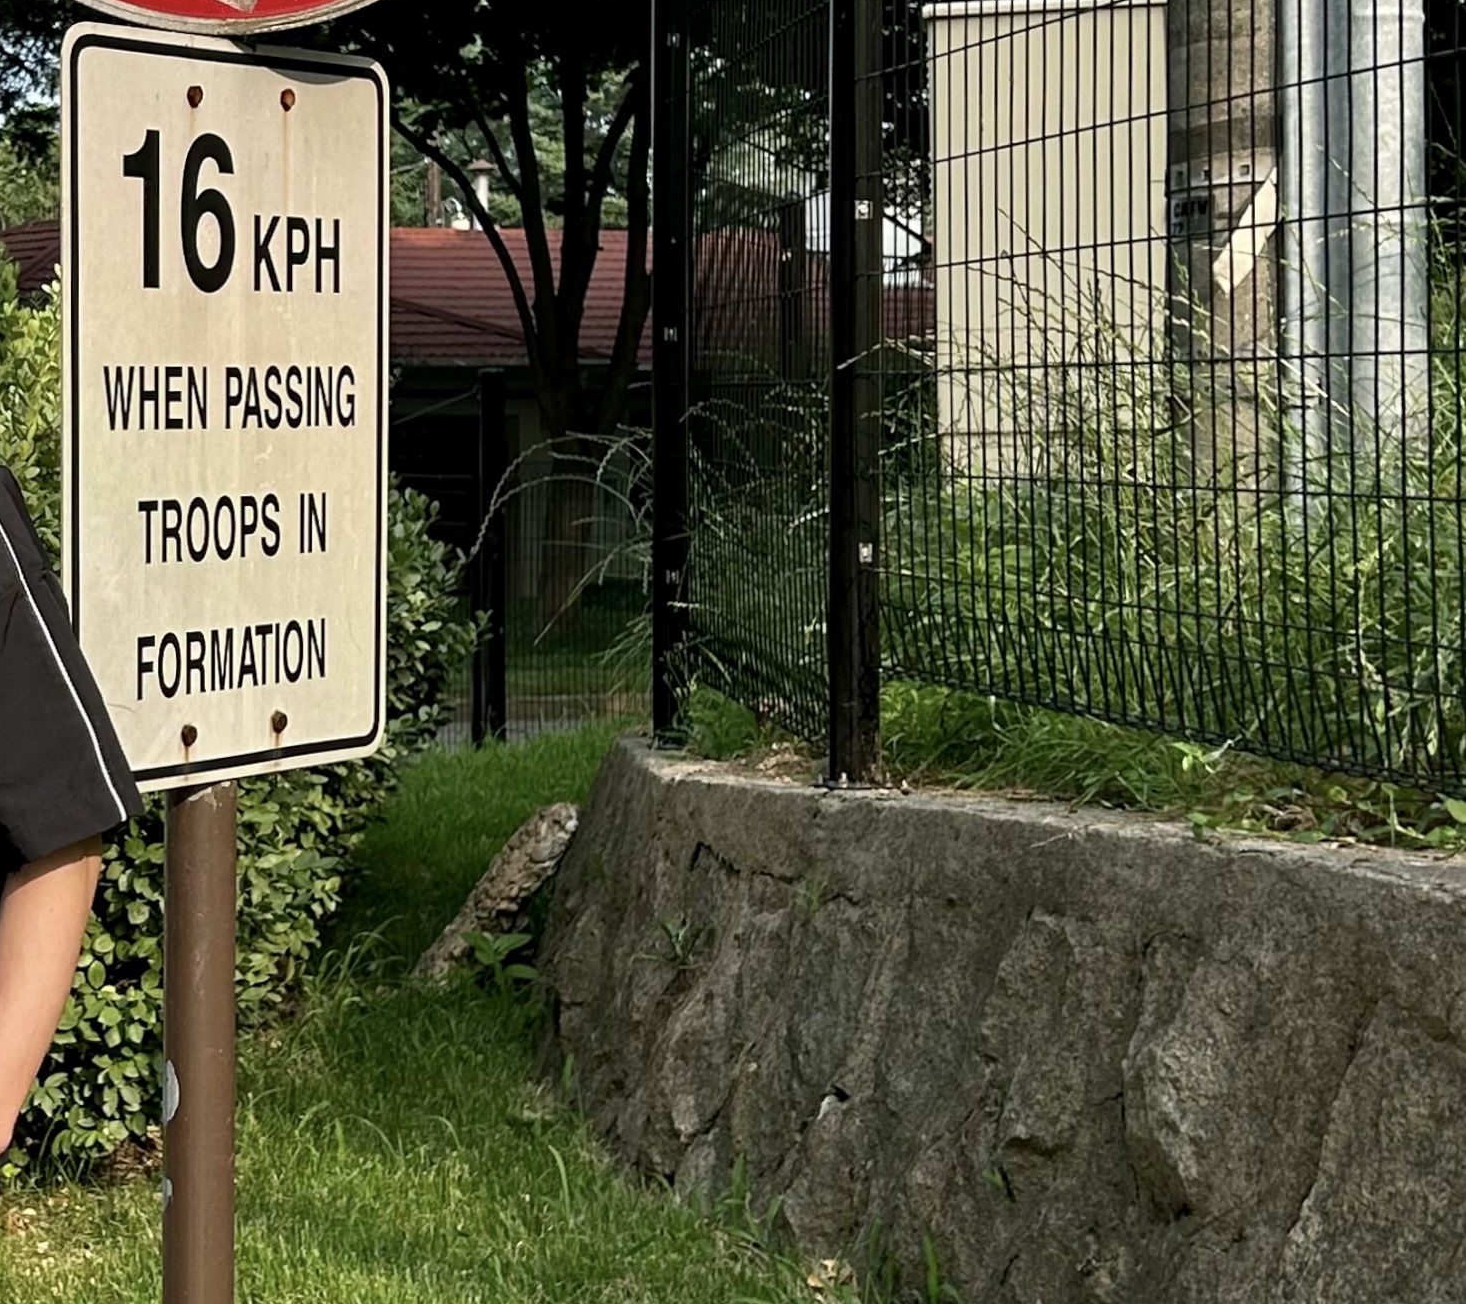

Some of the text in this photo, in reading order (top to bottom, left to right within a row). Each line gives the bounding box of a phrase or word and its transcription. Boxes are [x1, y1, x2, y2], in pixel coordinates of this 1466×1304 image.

[122, 129, 340, 294] 16 KPH
[103, 365, 356, 431] WHEN PASSING
[138, 492, 327, 564] TROOPS IN
[137, 617, 327, 701] FORMATION
